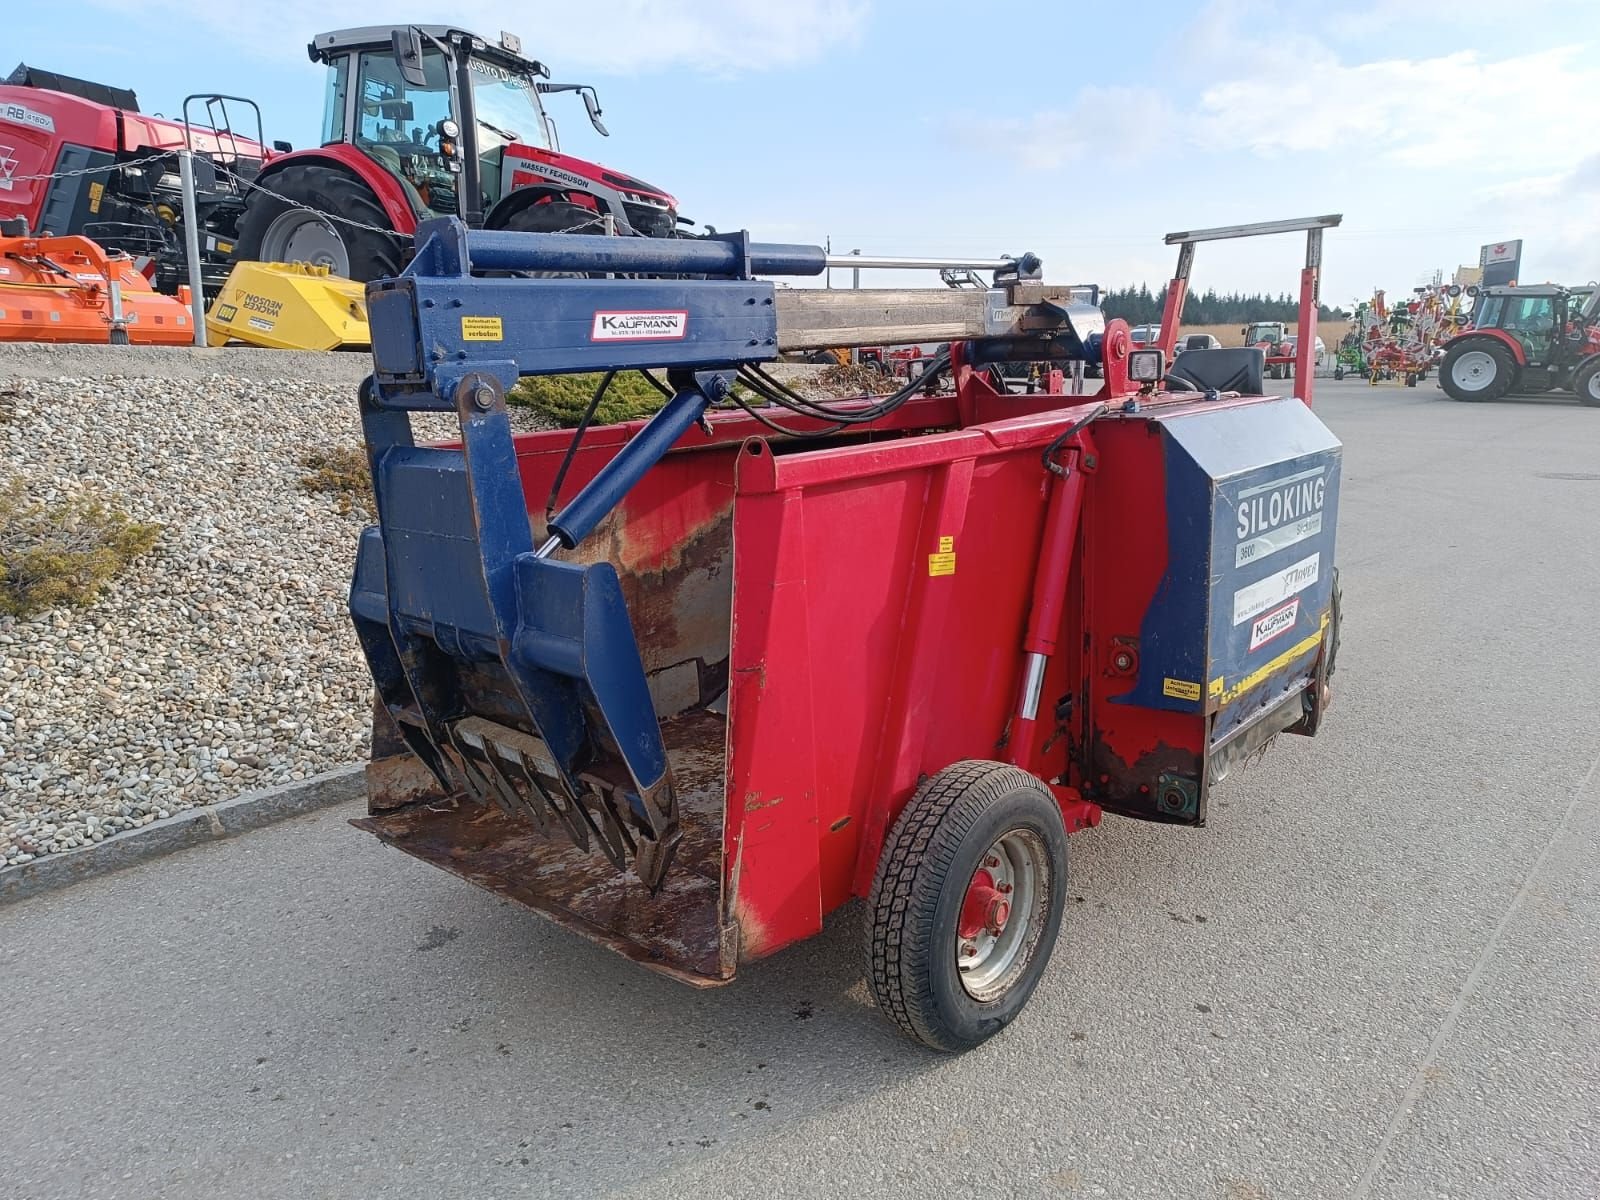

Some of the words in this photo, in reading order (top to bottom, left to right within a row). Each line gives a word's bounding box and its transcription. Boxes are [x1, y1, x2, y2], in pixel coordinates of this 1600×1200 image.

[467, 59, 498, 79] ustro
[499, 67, 531, 90] Diesel
[7, 106, 25, 120] RB
[520, 161, 549, 174] MASSEY
[550, 170, 590, 188] FERGUSON
[243, 301, 279, 318] WACKER
[245, 293, 283, 310] NEUSON
[602, 316, 678, 329] KAUFMANN
[1237, 477, 1324, 539] SILOKING
[1240, 544, 1255, 560] 3600
